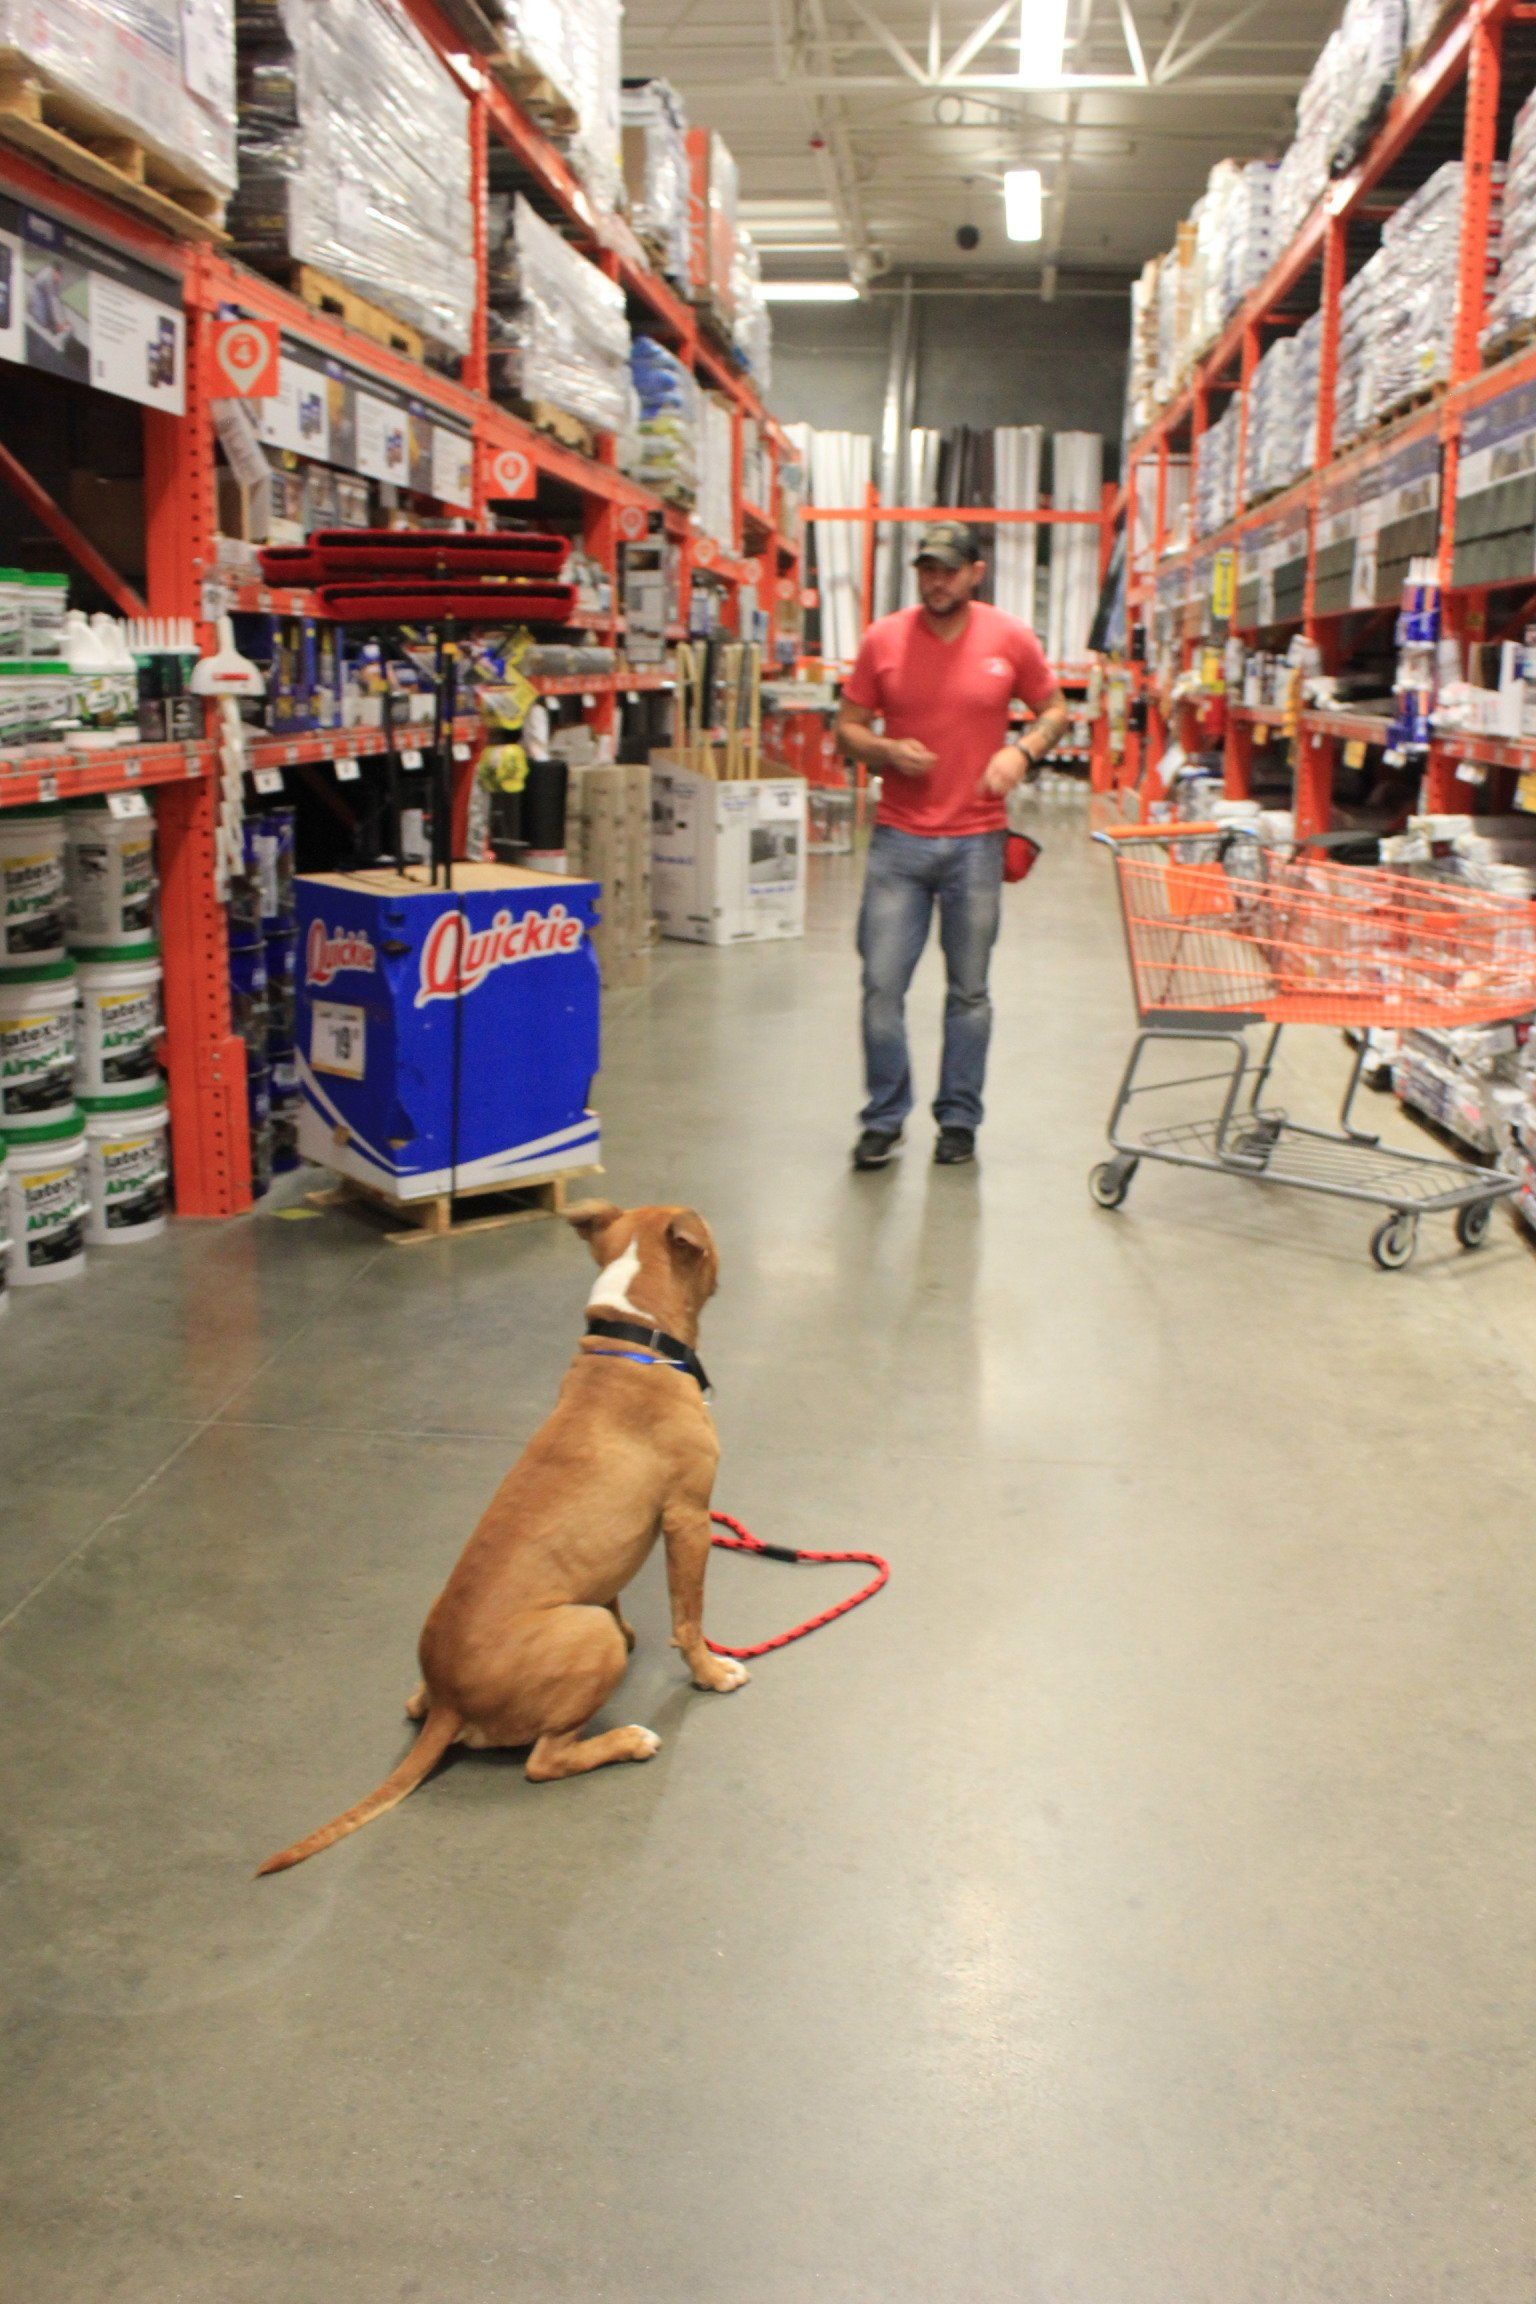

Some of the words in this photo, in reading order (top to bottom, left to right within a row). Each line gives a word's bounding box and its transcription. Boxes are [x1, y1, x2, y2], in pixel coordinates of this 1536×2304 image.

[234, 344, 251, 363] 4
[306, 918, 375, 986] Quickie
[415, 904, 583, 1008] Quickie
